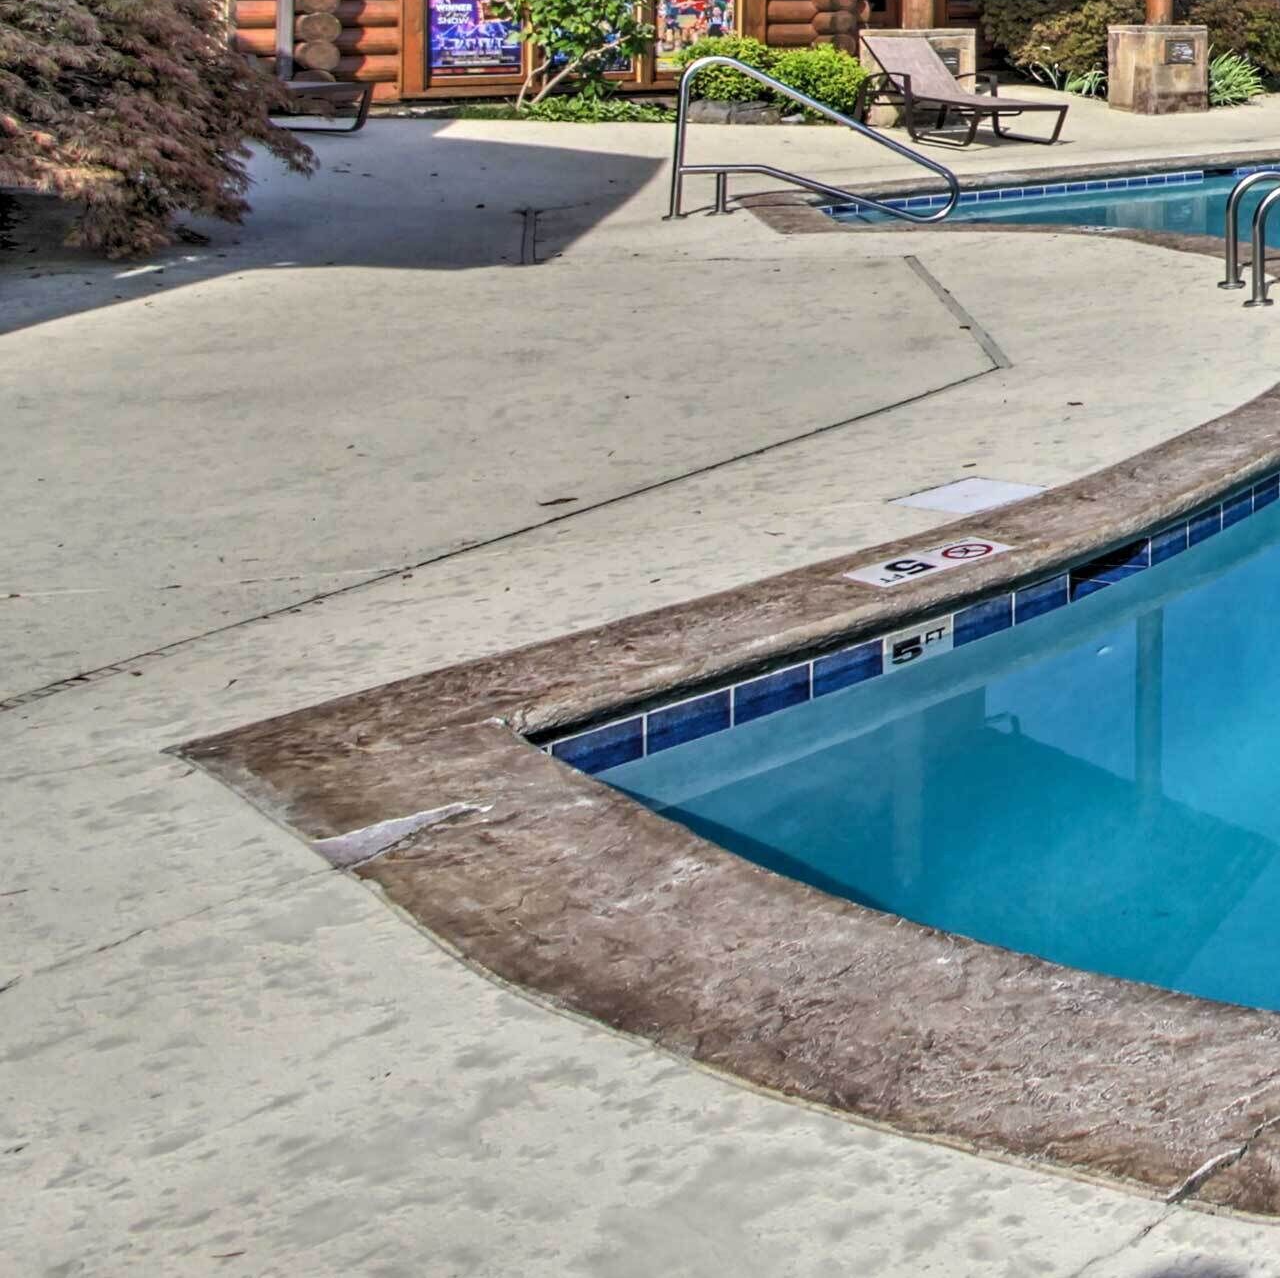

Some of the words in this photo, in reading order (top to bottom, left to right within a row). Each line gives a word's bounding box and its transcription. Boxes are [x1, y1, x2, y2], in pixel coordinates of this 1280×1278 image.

[436, 3, 473, 12] WINNER
[437, 16, 470, 25] SHOW
[892, 635, 923, 665] 5
[925, 626, 946, 645] FT
